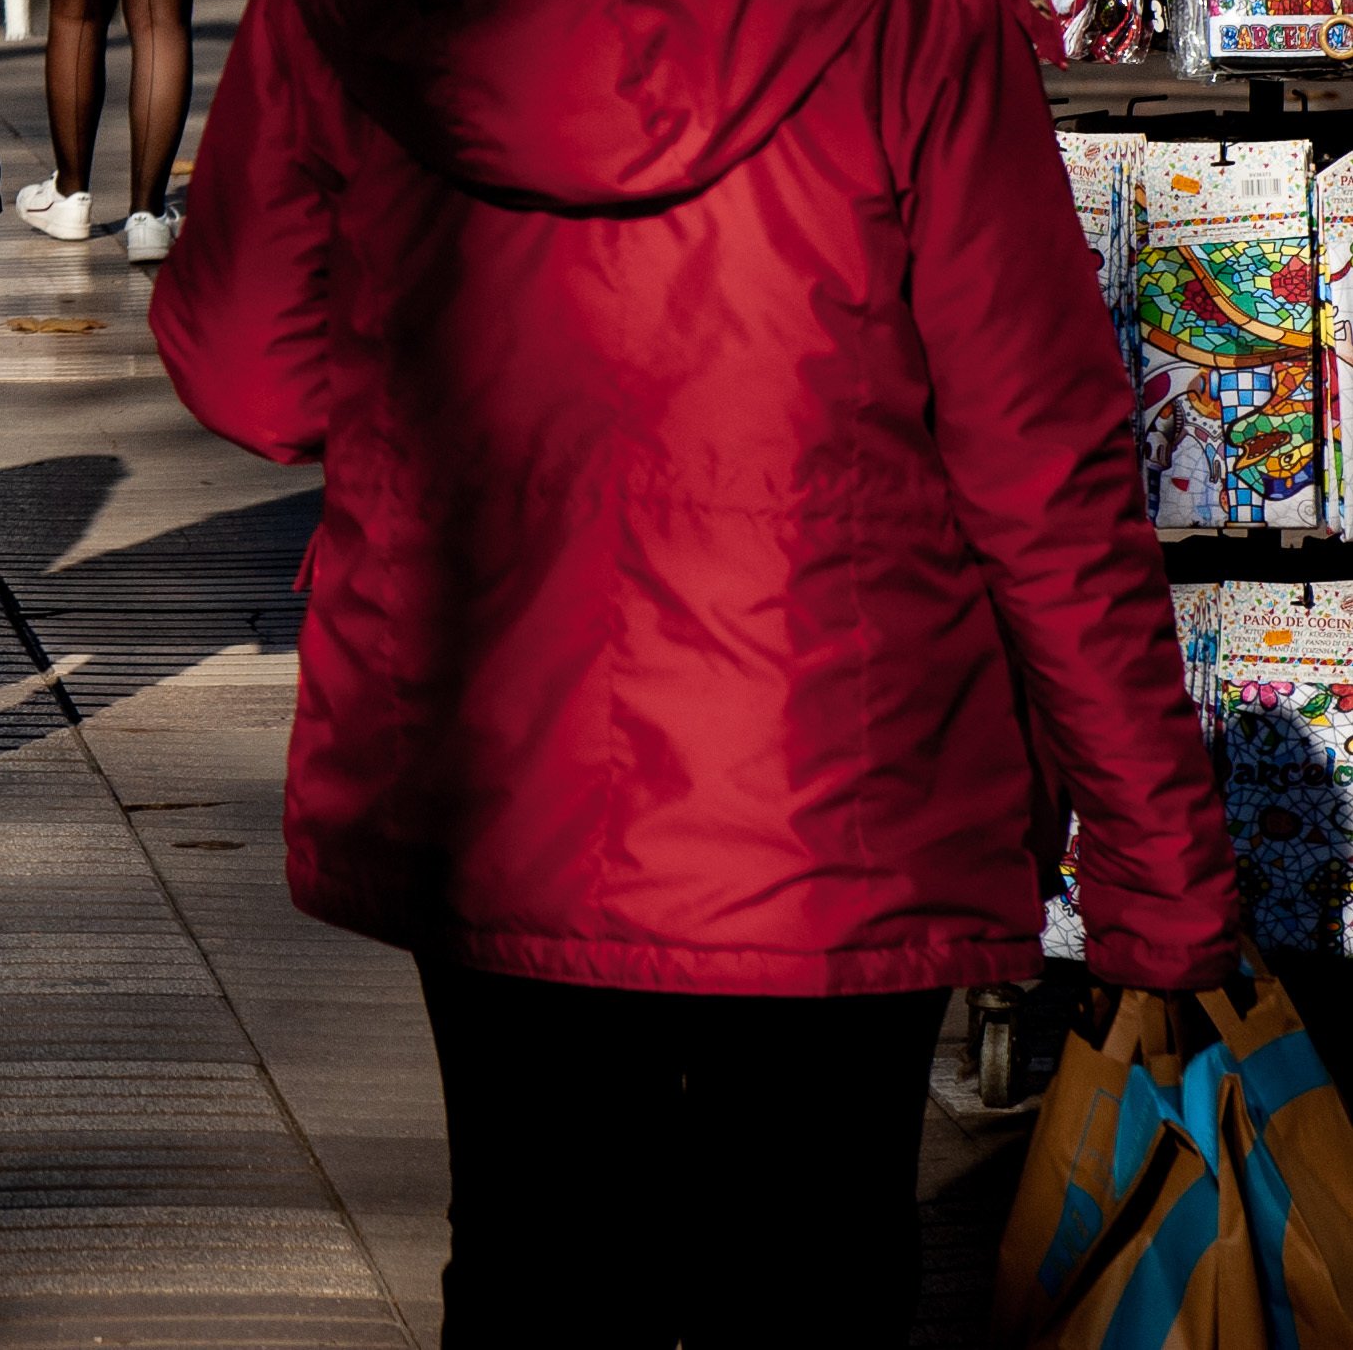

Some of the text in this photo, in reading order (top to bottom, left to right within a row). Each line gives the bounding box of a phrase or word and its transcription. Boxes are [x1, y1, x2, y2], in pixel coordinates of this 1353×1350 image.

[1243, 612, 1353, 630] PAÑO DE COCIN
